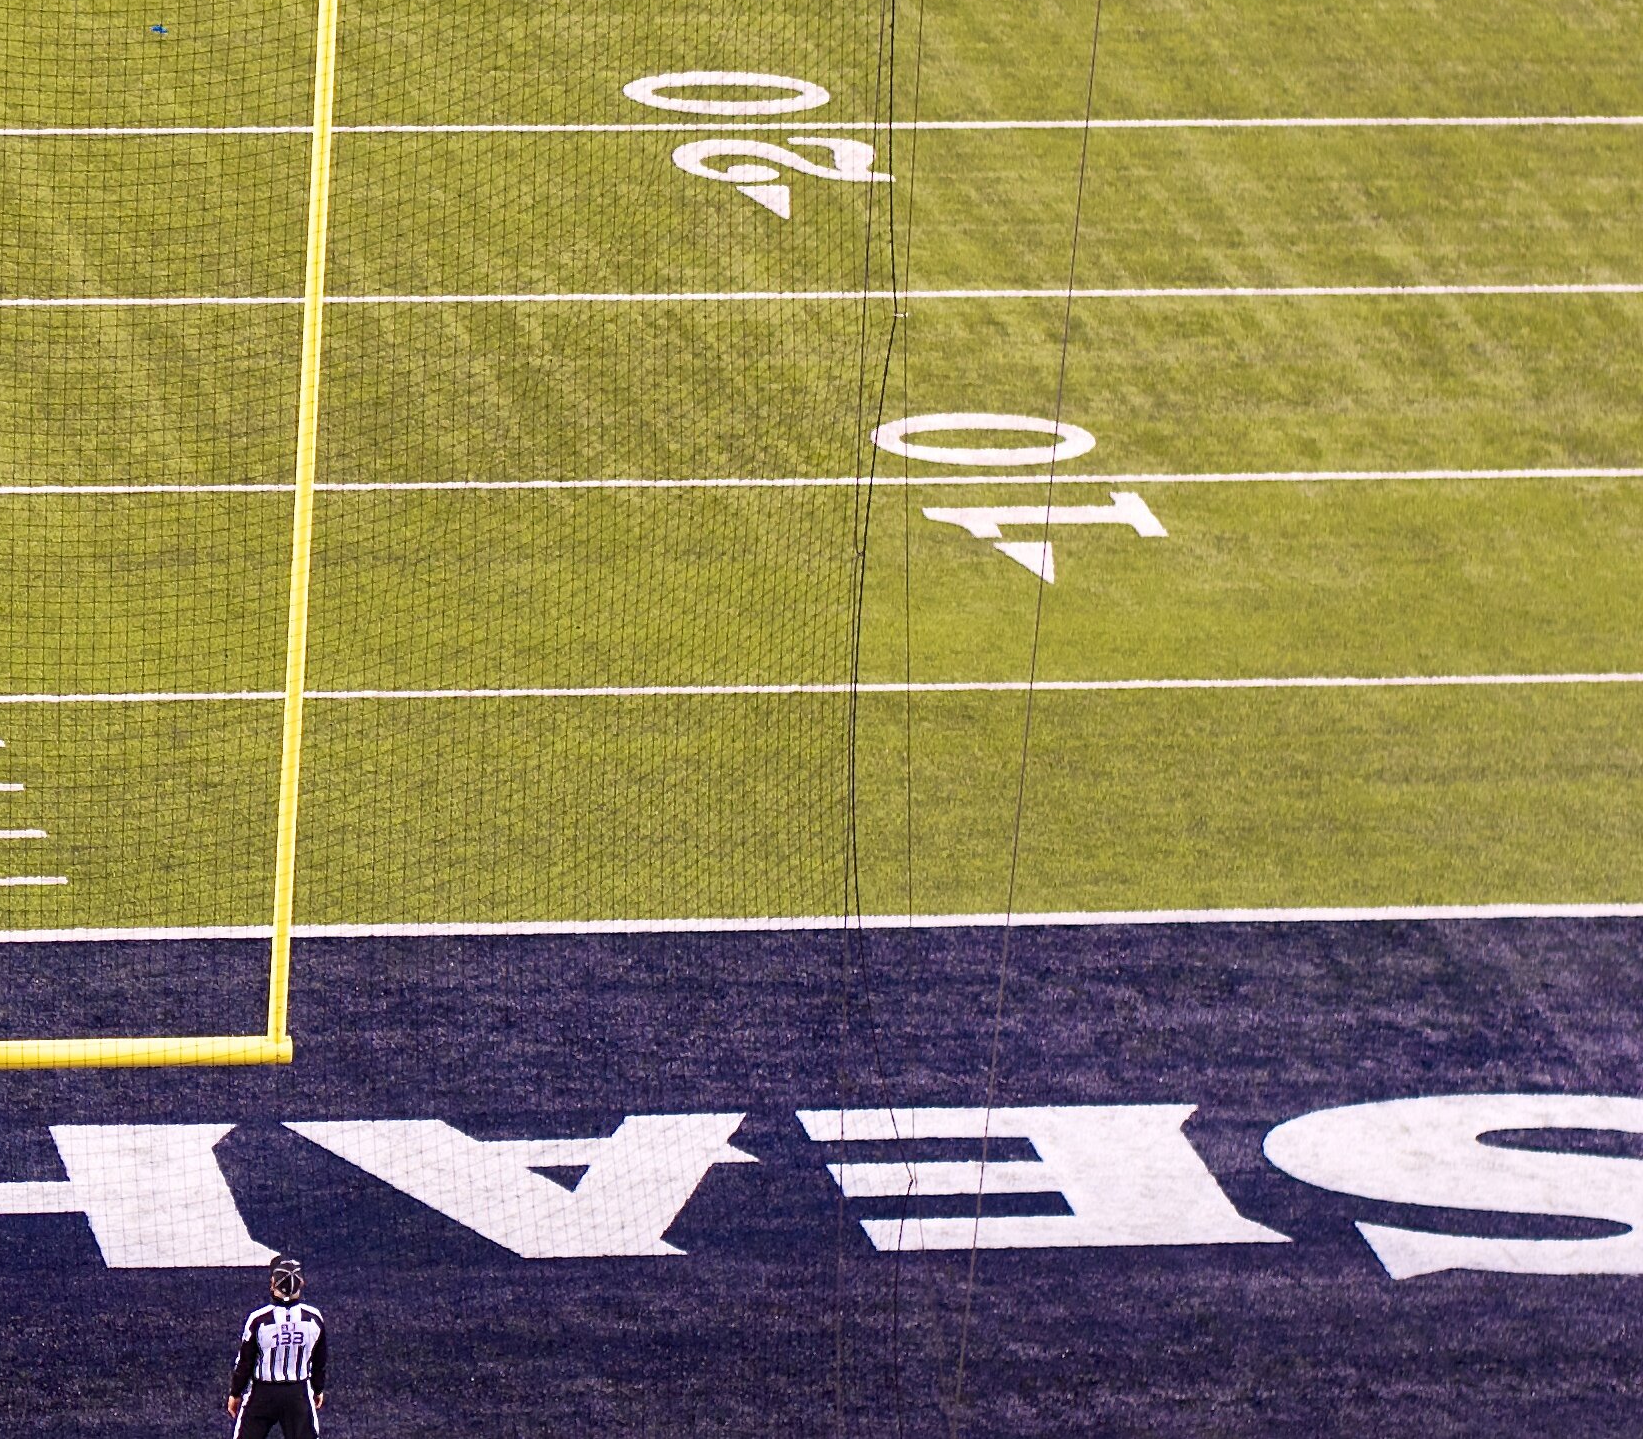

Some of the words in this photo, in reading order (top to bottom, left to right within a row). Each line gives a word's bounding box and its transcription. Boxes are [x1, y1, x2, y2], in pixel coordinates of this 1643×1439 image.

[622, 71, 896, 182] 20
[870, 412, 1169, 538] 10
[271, 1331, 305, 1346] 133
